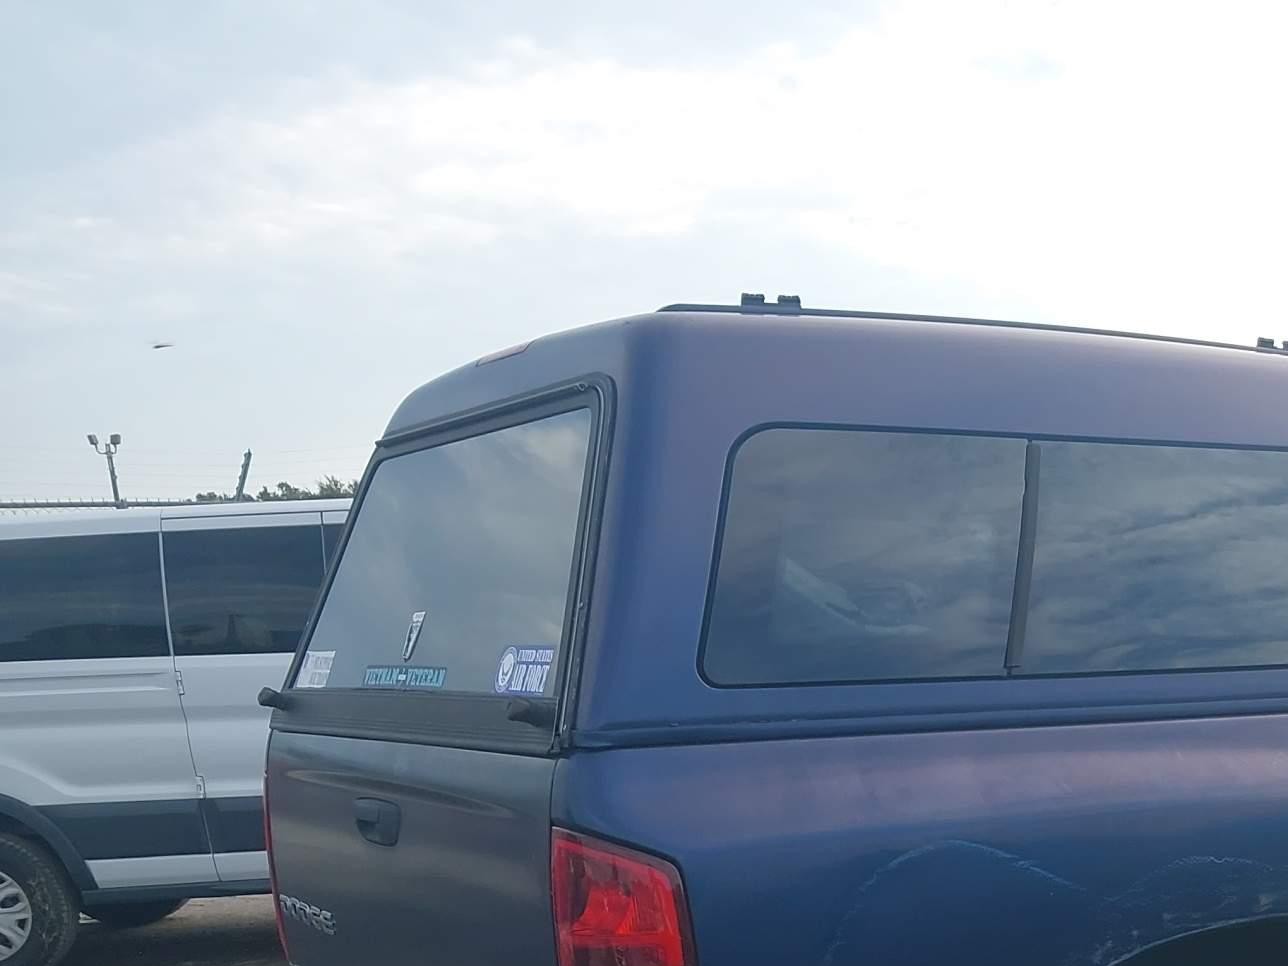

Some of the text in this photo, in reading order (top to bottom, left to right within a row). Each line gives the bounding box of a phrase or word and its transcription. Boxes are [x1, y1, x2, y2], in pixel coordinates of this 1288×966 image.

[517, 649, 554, 662] UNITED STATES
[364, 668, 446, 687] VIETNAM VETERAN
[510, 664, 550, 692] AIR FORCE
